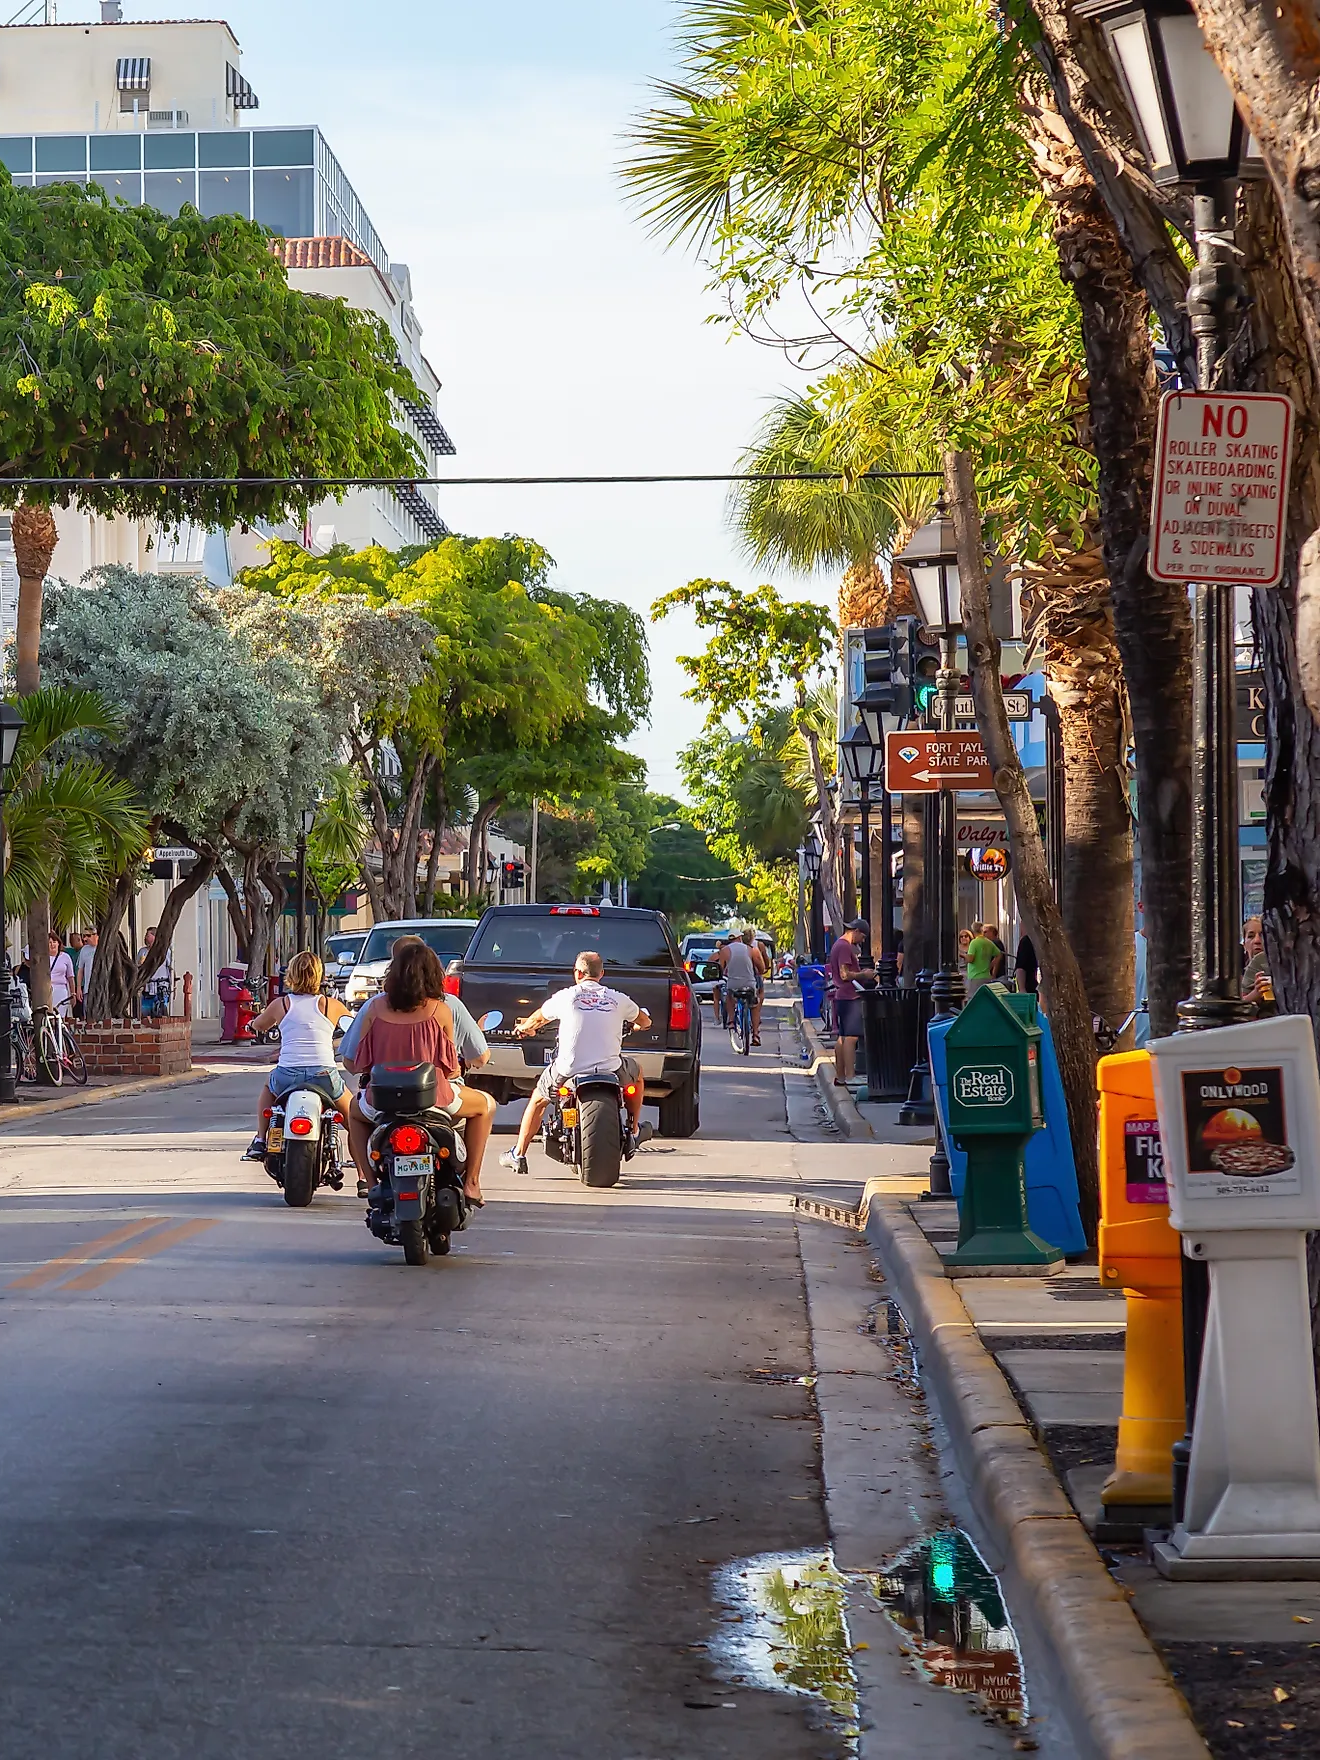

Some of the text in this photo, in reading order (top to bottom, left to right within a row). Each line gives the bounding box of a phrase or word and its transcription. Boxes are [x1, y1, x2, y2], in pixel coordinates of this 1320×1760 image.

[1202, 404, 1248, 439] NO
[1169, 440, 1278, 460] ROLLER SKATING
[1166, 480, 1277, 499] OR INLINE SKATING
[1184, 500, 1200, 515] ON
[1162, 519, 1276, 539] ADJACENT STREETS
[1172, 539, 1255, 558] & SIDEWALKS
[1166, 562, 1266, 577] PER CITY ORDINANCE
[1007, 699, 1020, 712] St
[926, 742, 985, 753] FORT TAYL
[928, 756, 991, 767] STATE PAR
[970, 1070, 1005, 1086] Real
[961, 1083, 1008, 1098] Estate
[1200, 1083, 1269, 1099] ONLYWOOD
[1126, 1123, 1151, 1132] MAP
